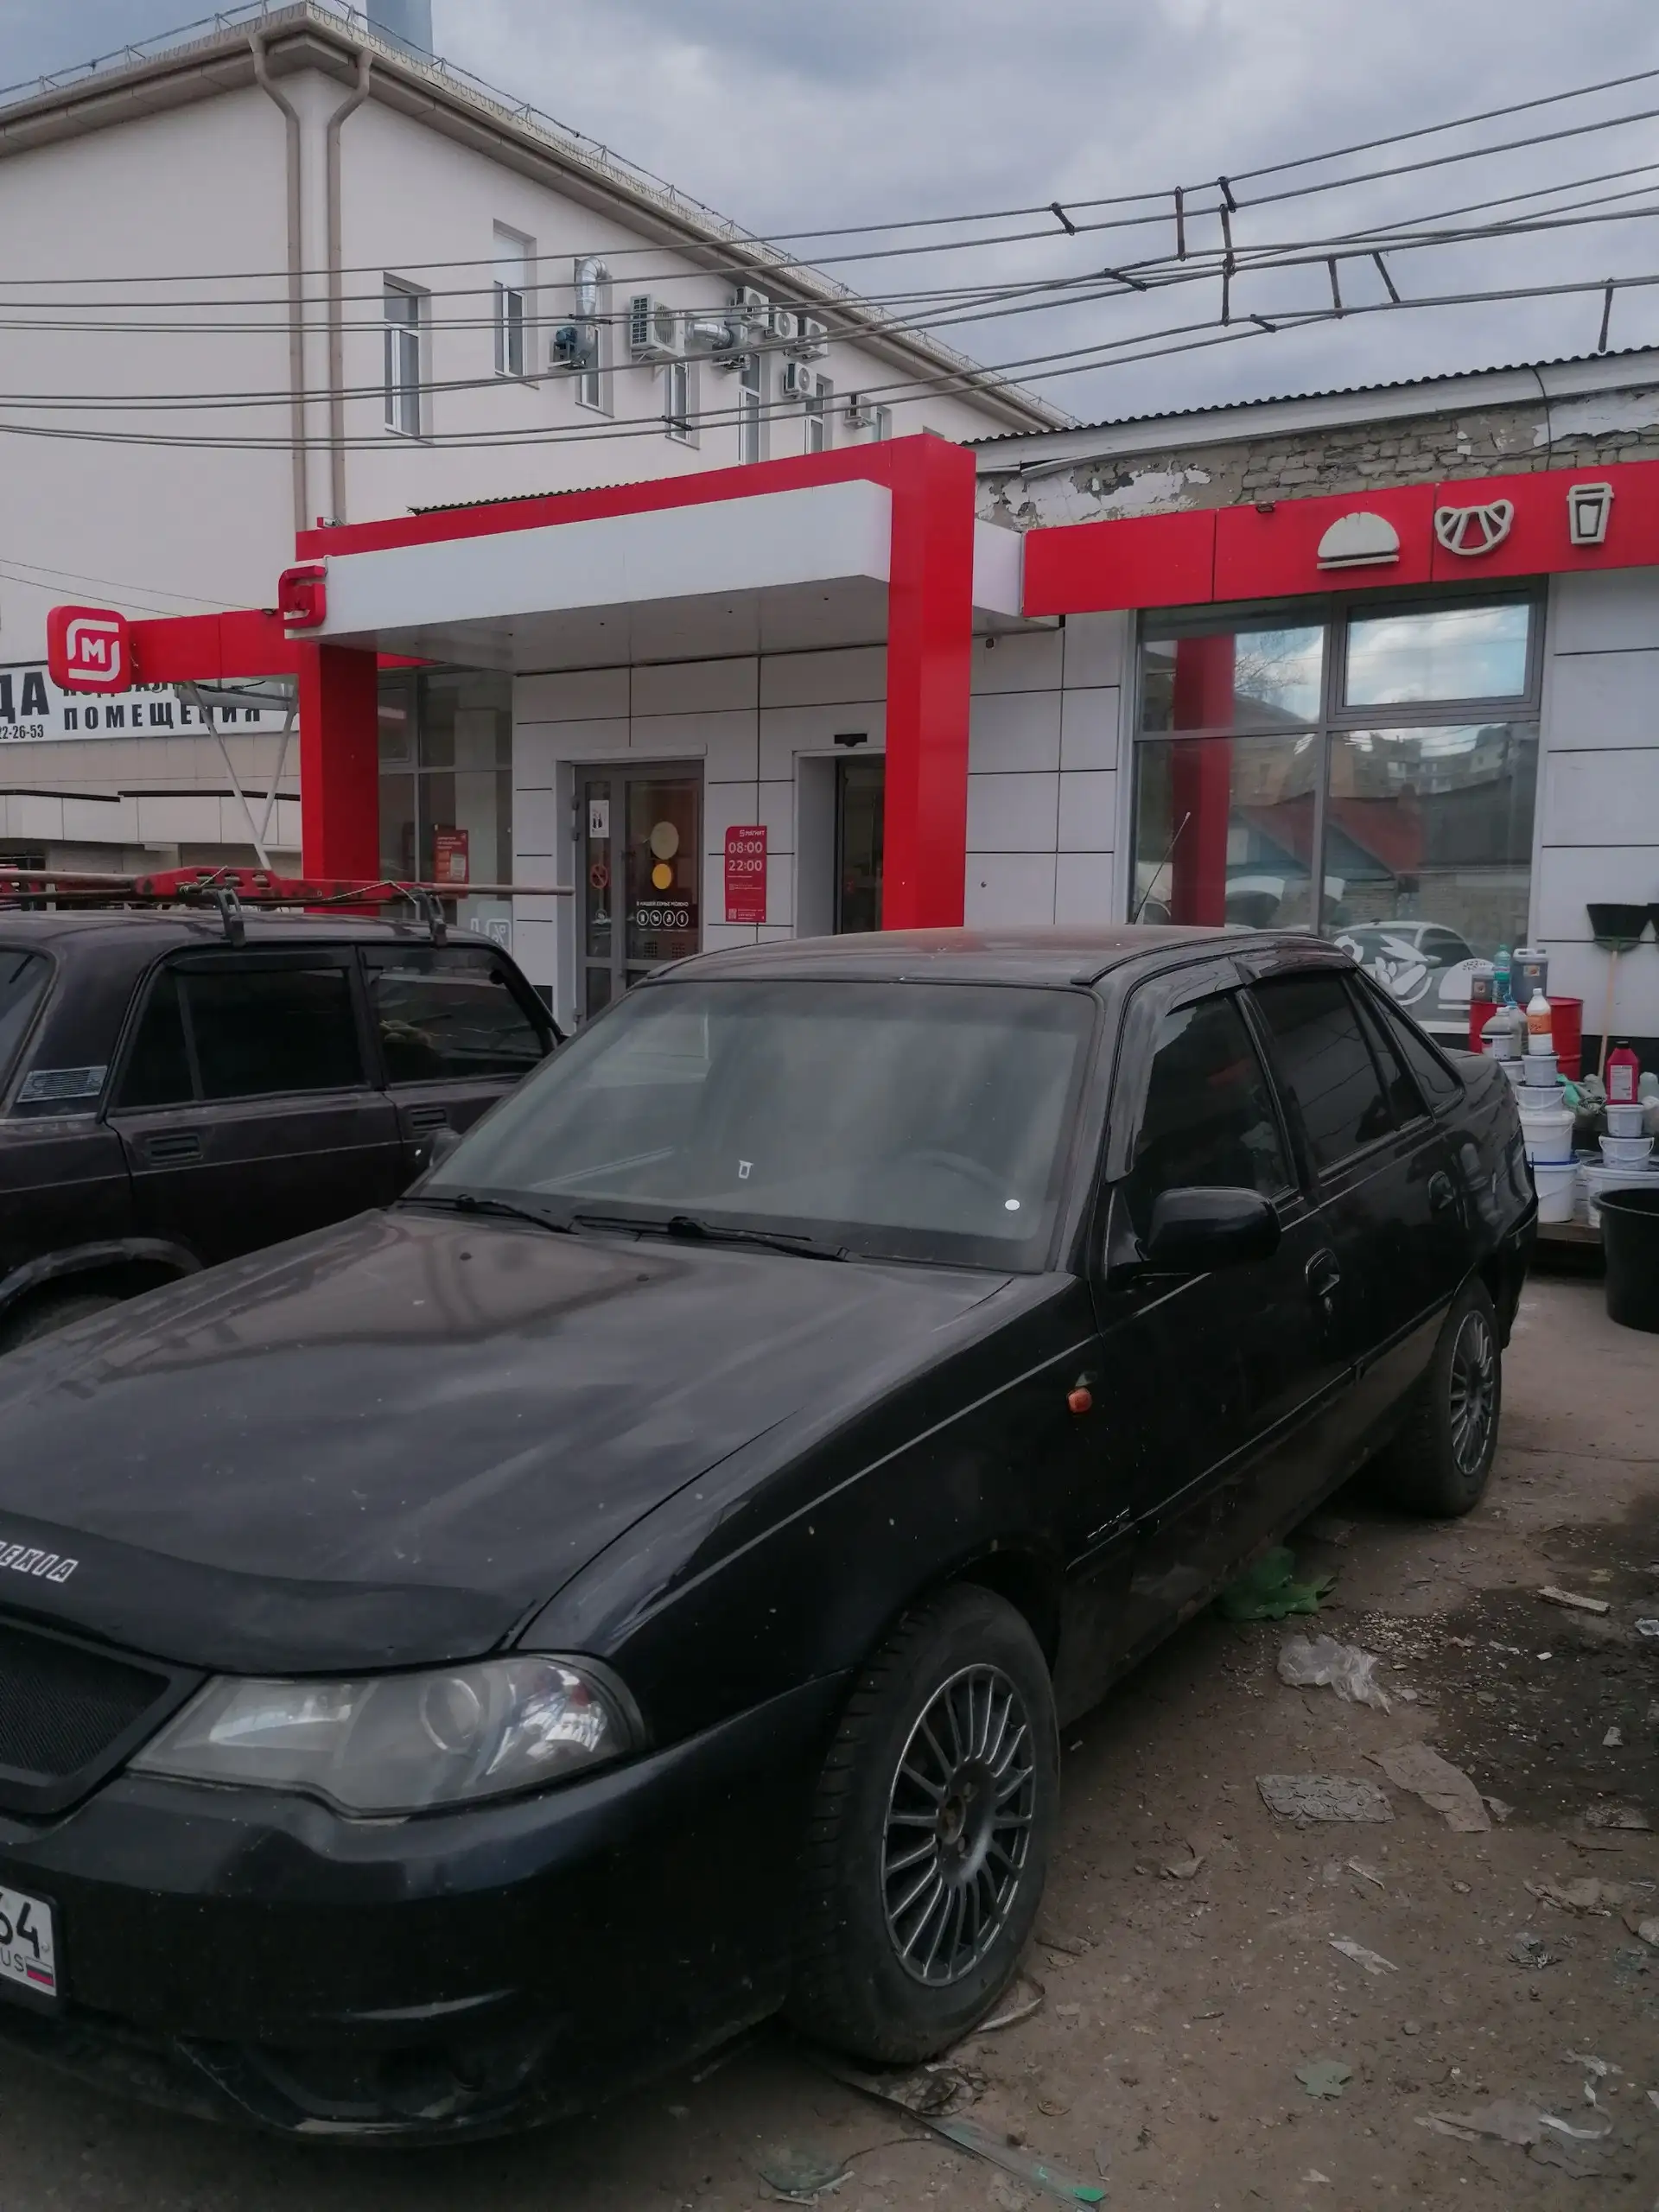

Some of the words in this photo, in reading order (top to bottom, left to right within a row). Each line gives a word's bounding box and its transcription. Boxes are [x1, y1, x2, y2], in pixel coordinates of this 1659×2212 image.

[0, 724, 44, 740] 2-26-53
[728, 842, 763, 854] 08:00
[728, 860, 763, 872] 22:00
[0, 1540, 79, 1583] EXIA
